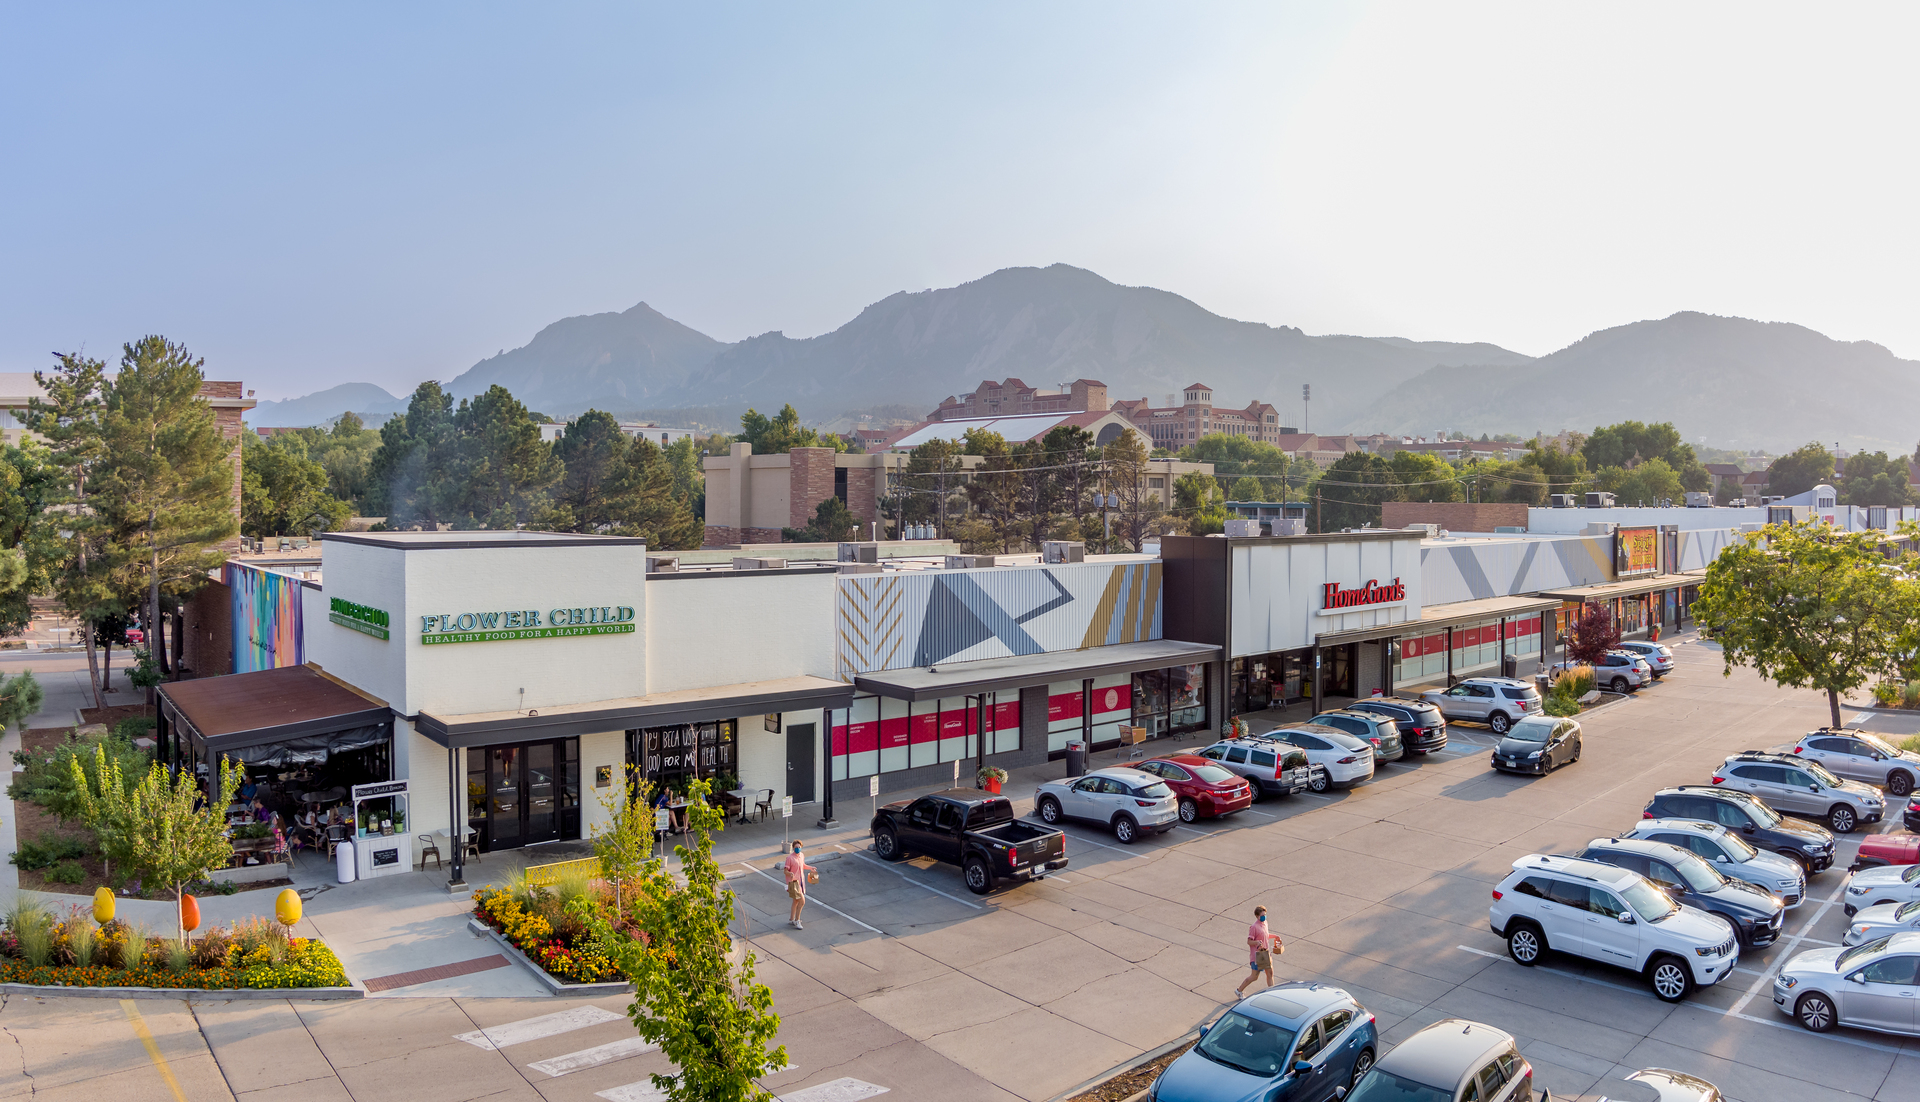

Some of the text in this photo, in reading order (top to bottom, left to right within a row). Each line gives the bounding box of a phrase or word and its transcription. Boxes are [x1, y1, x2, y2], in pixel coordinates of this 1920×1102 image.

[1322, 577, 1405, 609] HomeGoods
[421, 606, 636, 633] FLOWER CHILD
[425, 624, 635, 643] HEALTHY FOOD FOR A HAPPY WORLD
[646, 754, 661, 772] OOD
[664, 755, 680, 767] FOR
